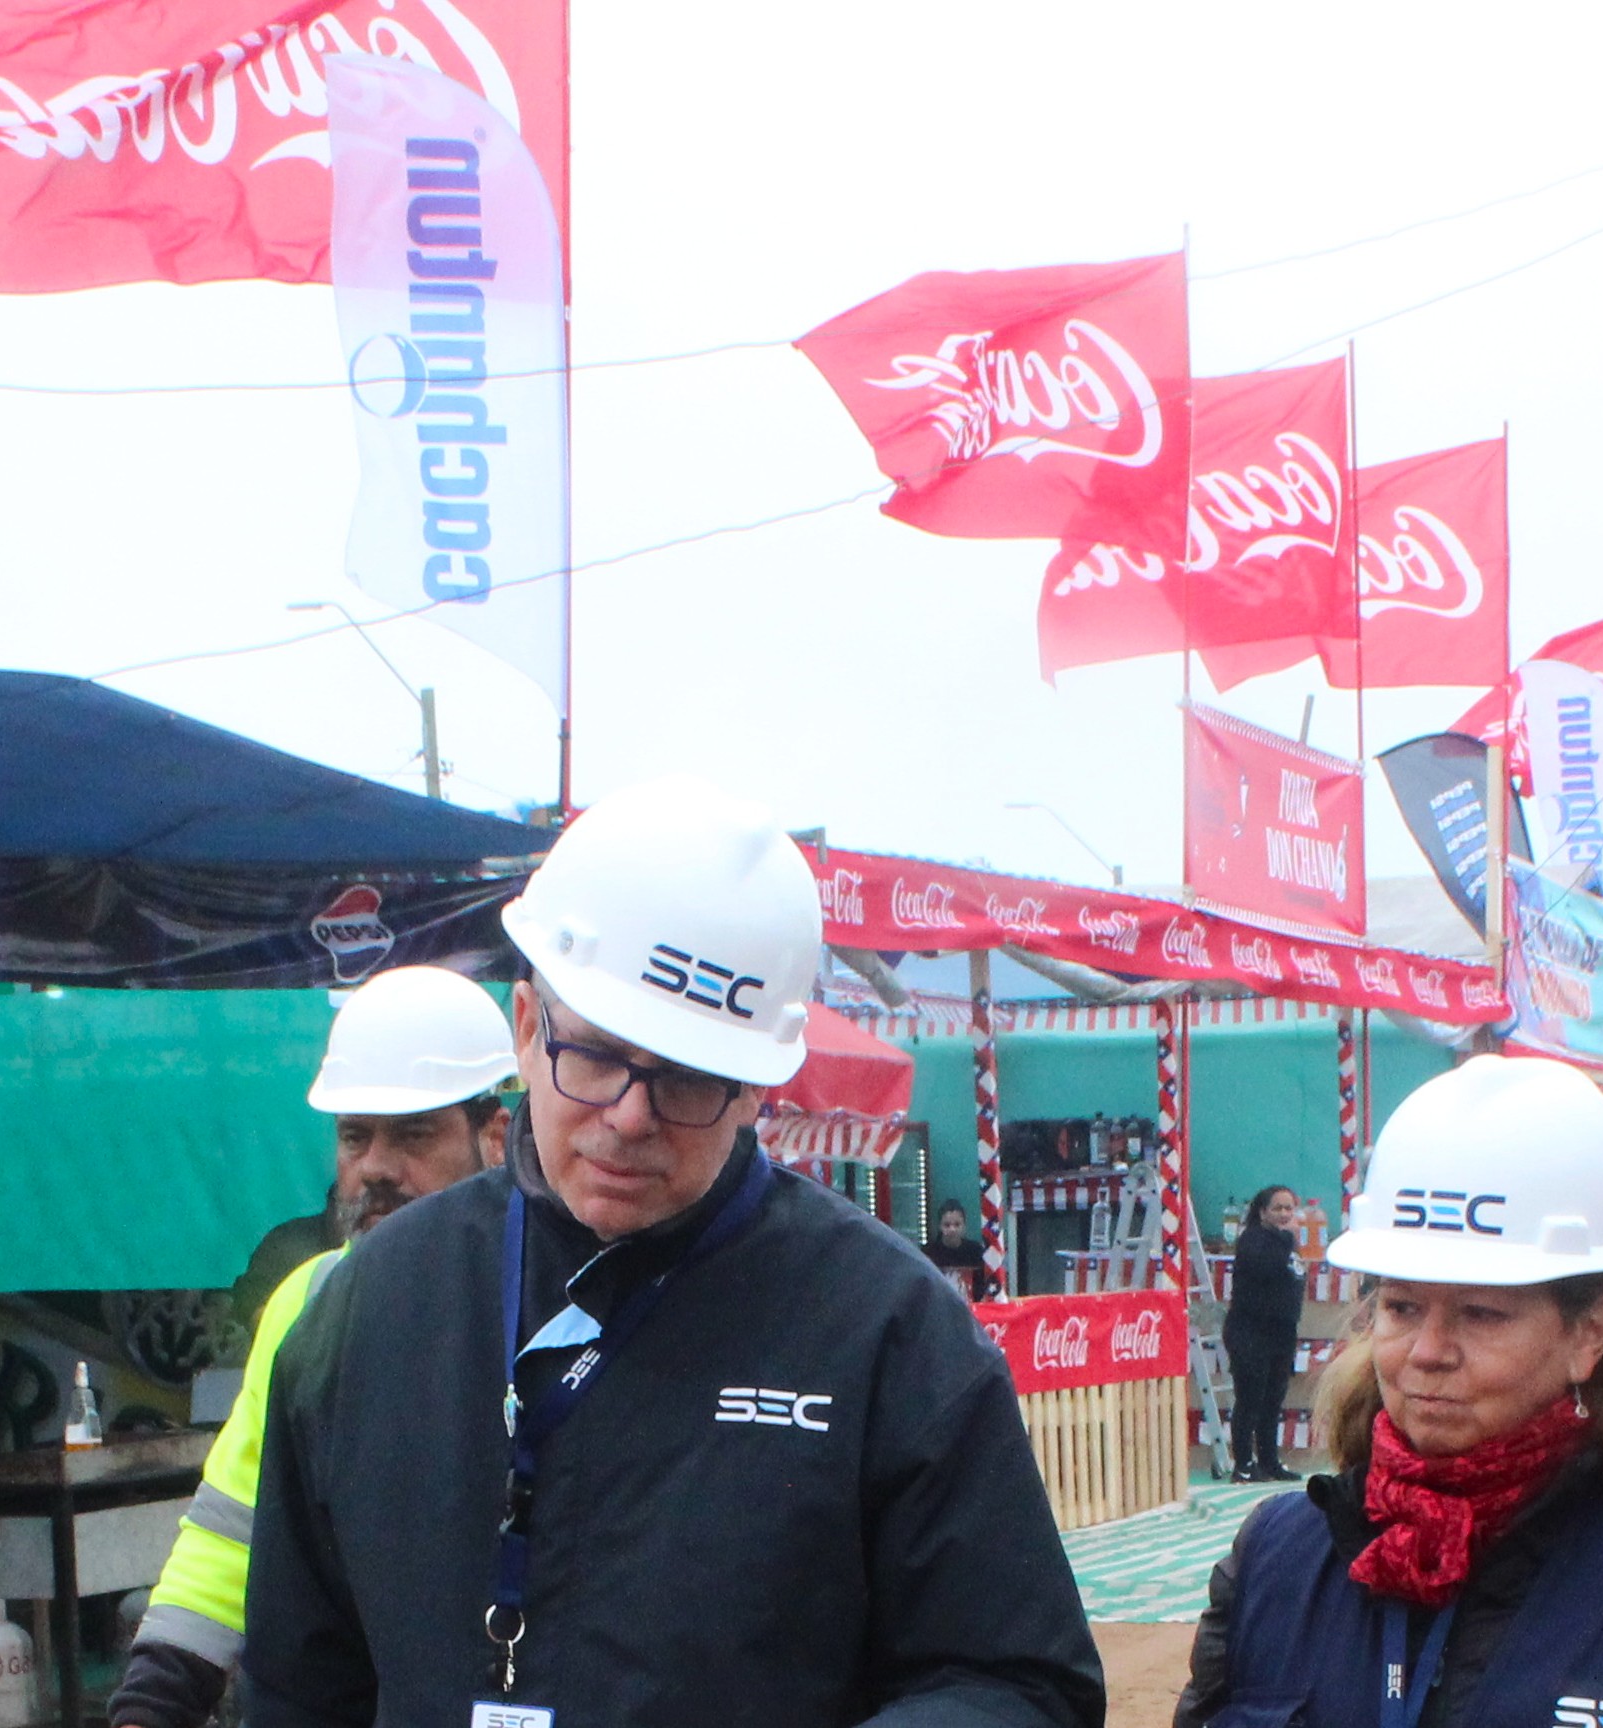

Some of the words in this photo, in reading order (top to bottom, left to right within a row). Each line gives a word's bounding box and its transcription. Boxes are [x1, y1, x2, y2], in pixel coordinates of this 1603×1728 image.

[1278, 768, 1319, 829] FONDA
[1266, 826, 1293, 881] DON
[317, 921, 388, 945] PEPSI
[641, 943, 765, 1019] SEC
[1393, 1188, 1505, 1236] SEC
[715, 1387, 833, 1431] SEC
